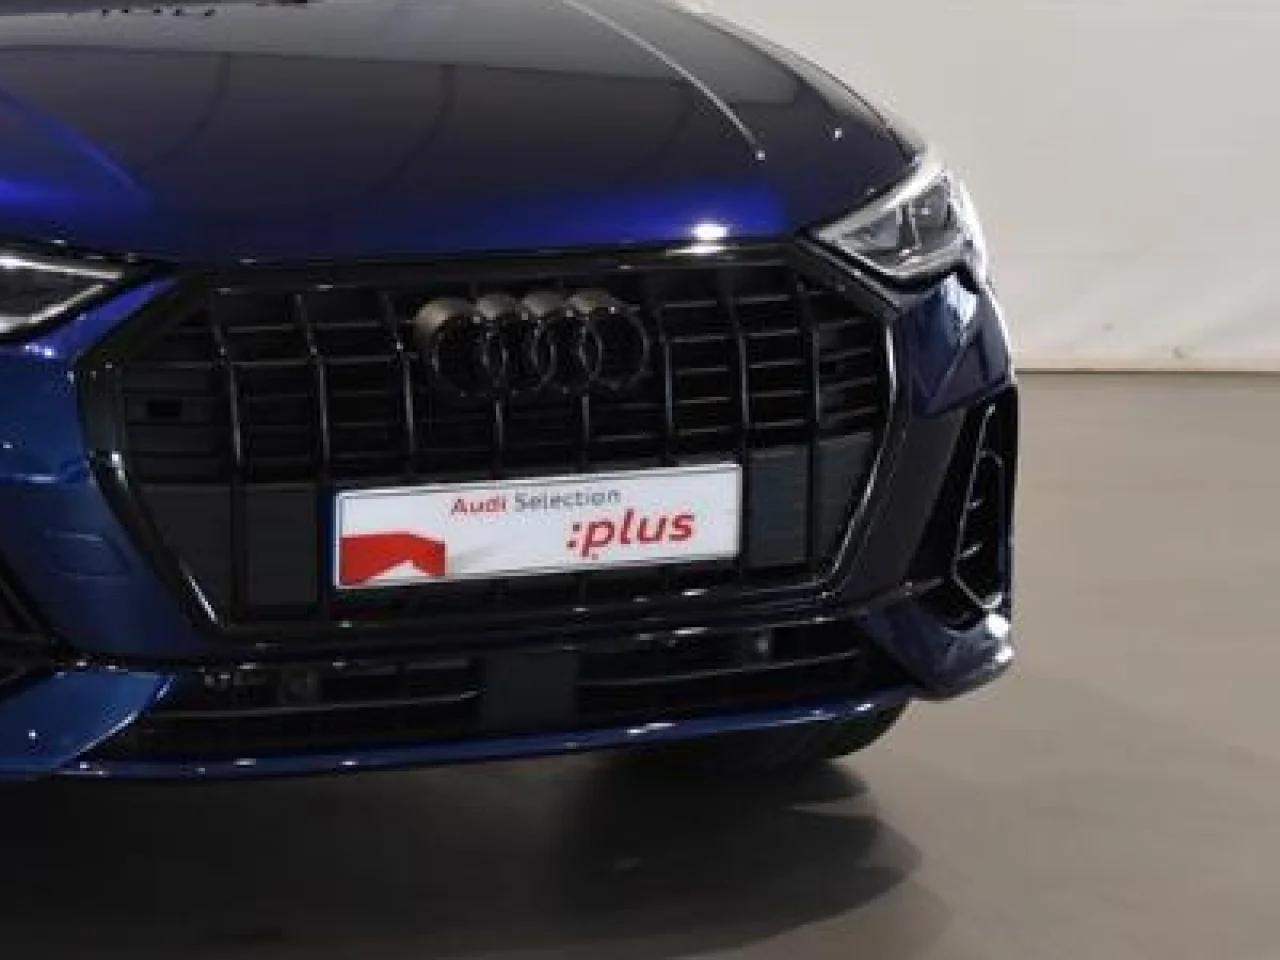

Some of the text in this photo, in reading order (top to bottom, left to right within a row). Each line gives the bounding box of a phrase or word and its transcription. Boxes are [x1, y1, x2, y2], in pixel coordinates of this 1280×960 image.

[451, 488, 622, 515] Audi Selection
[566, 507, 696, 558] :plus
